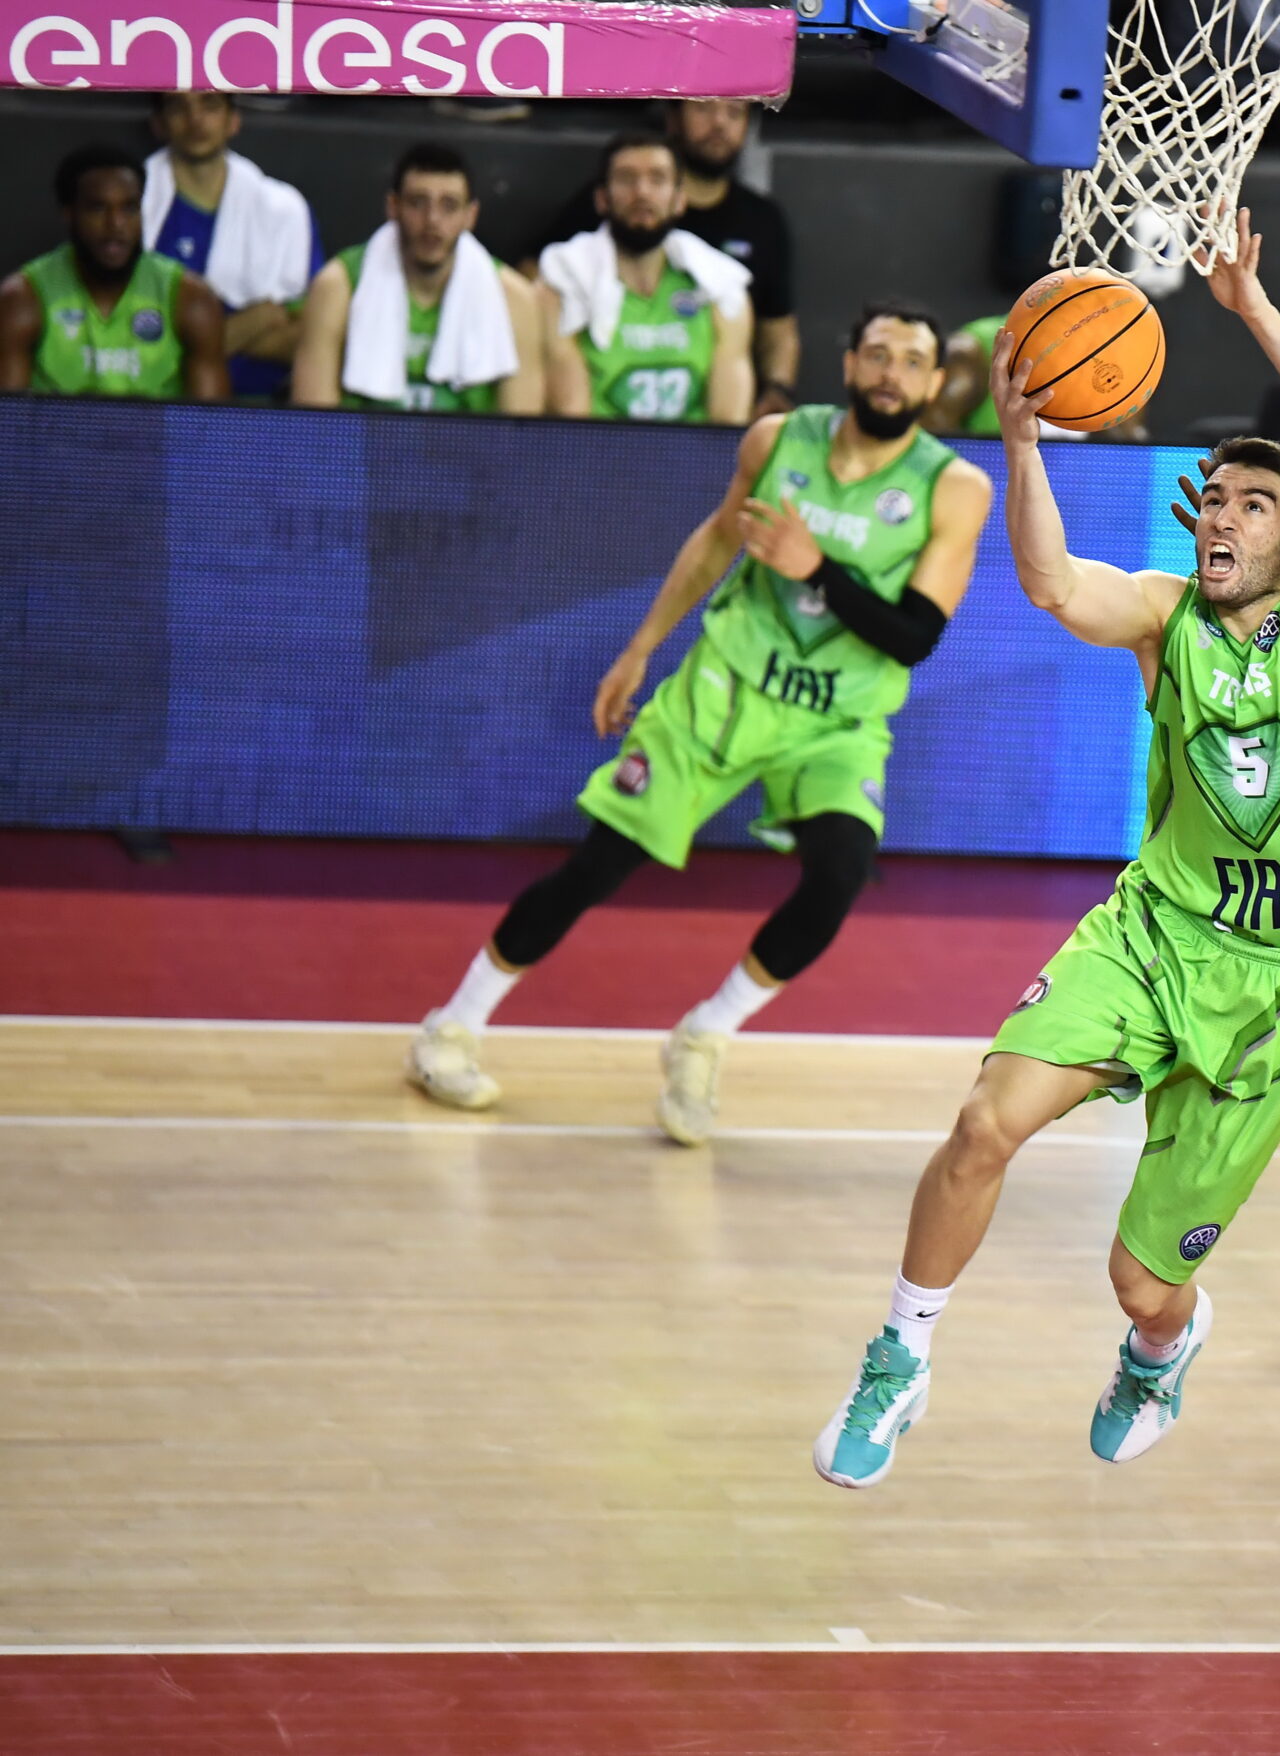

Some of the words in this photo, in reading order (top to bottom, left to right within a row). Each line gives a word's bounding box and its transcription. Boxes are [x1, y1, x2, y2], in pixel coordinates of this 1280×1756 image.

[9, 0, 564, 97] endesa
[1063, 305, 1110, 339] CHAMPIONS
[1228, 735, 1268, 797] 5
